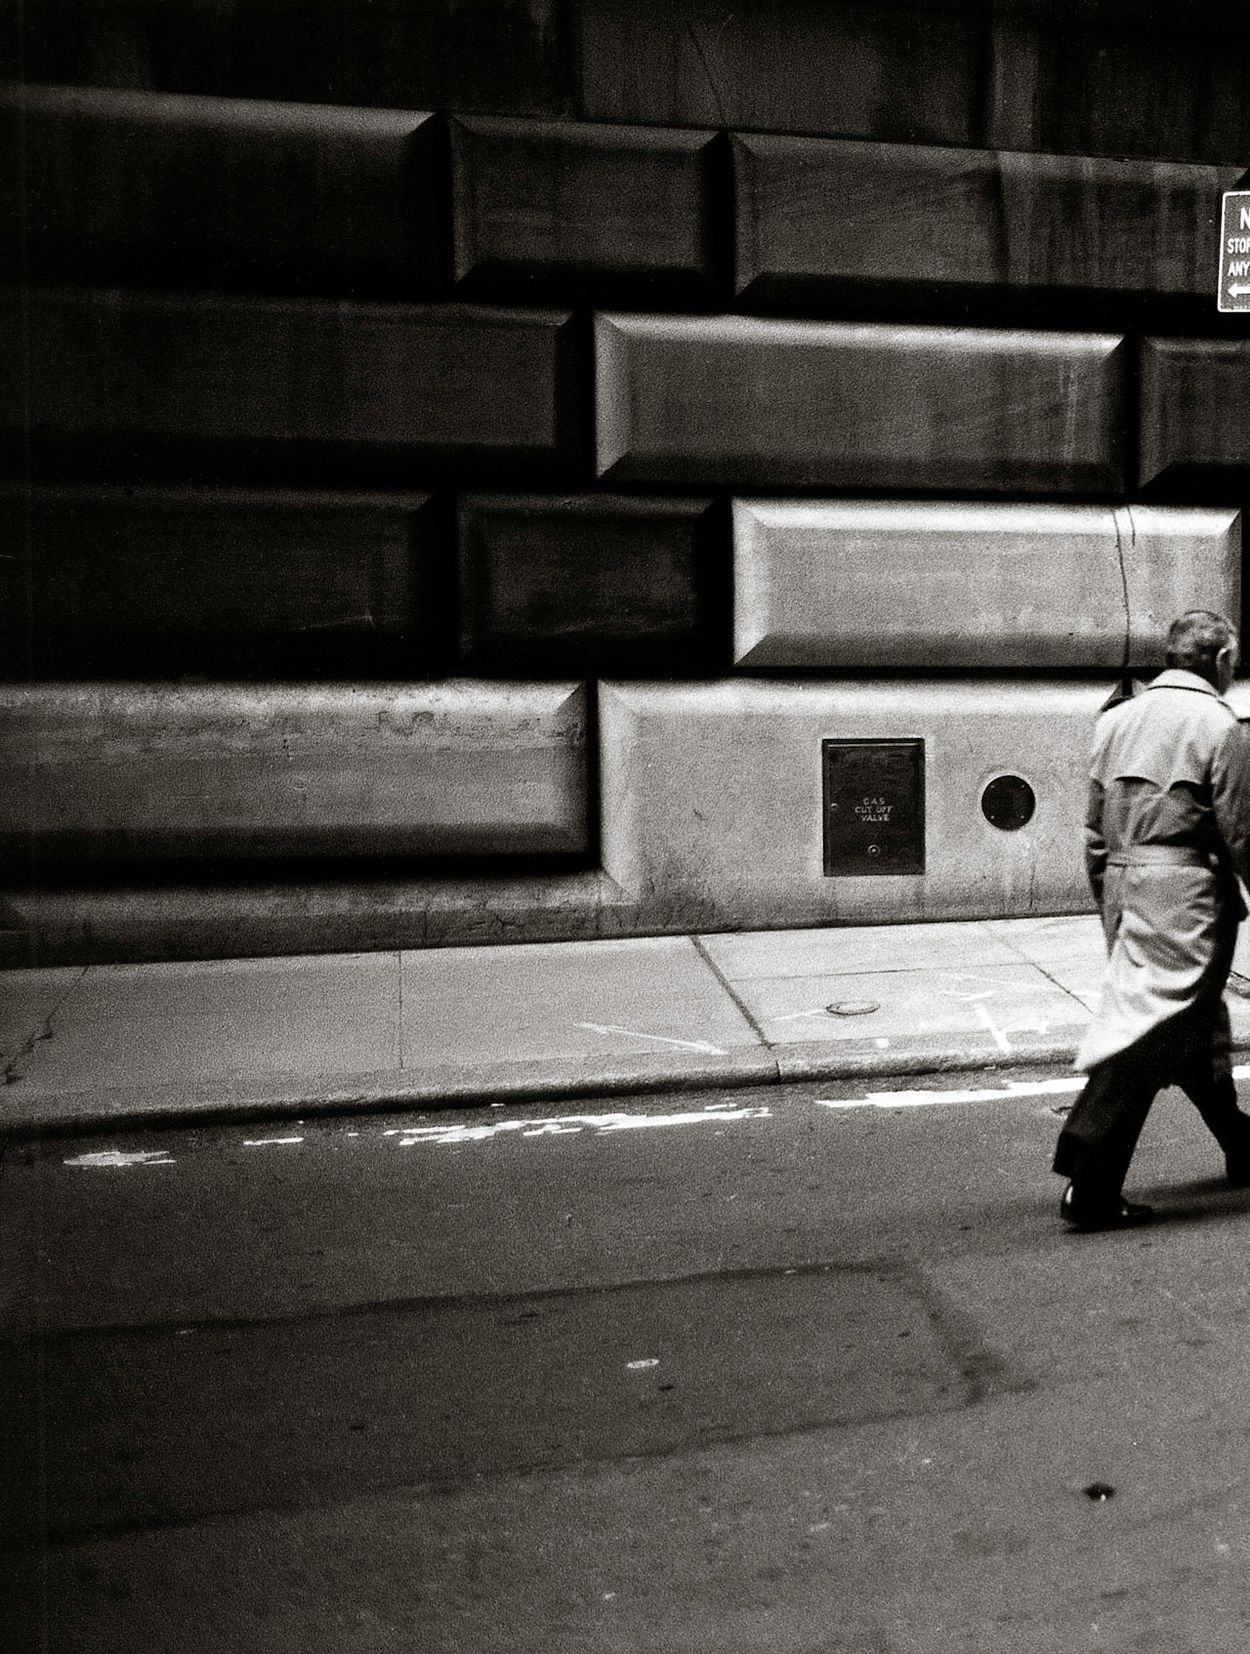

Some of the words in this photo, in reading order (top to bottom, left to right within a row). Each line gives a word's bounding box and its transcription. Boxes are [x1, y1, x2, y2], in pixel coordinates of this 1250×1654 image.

[863, 797, 885, 805] GAS
[855, 806, 872, 814] CUT
[861, 814, 889, 822] VALVE
